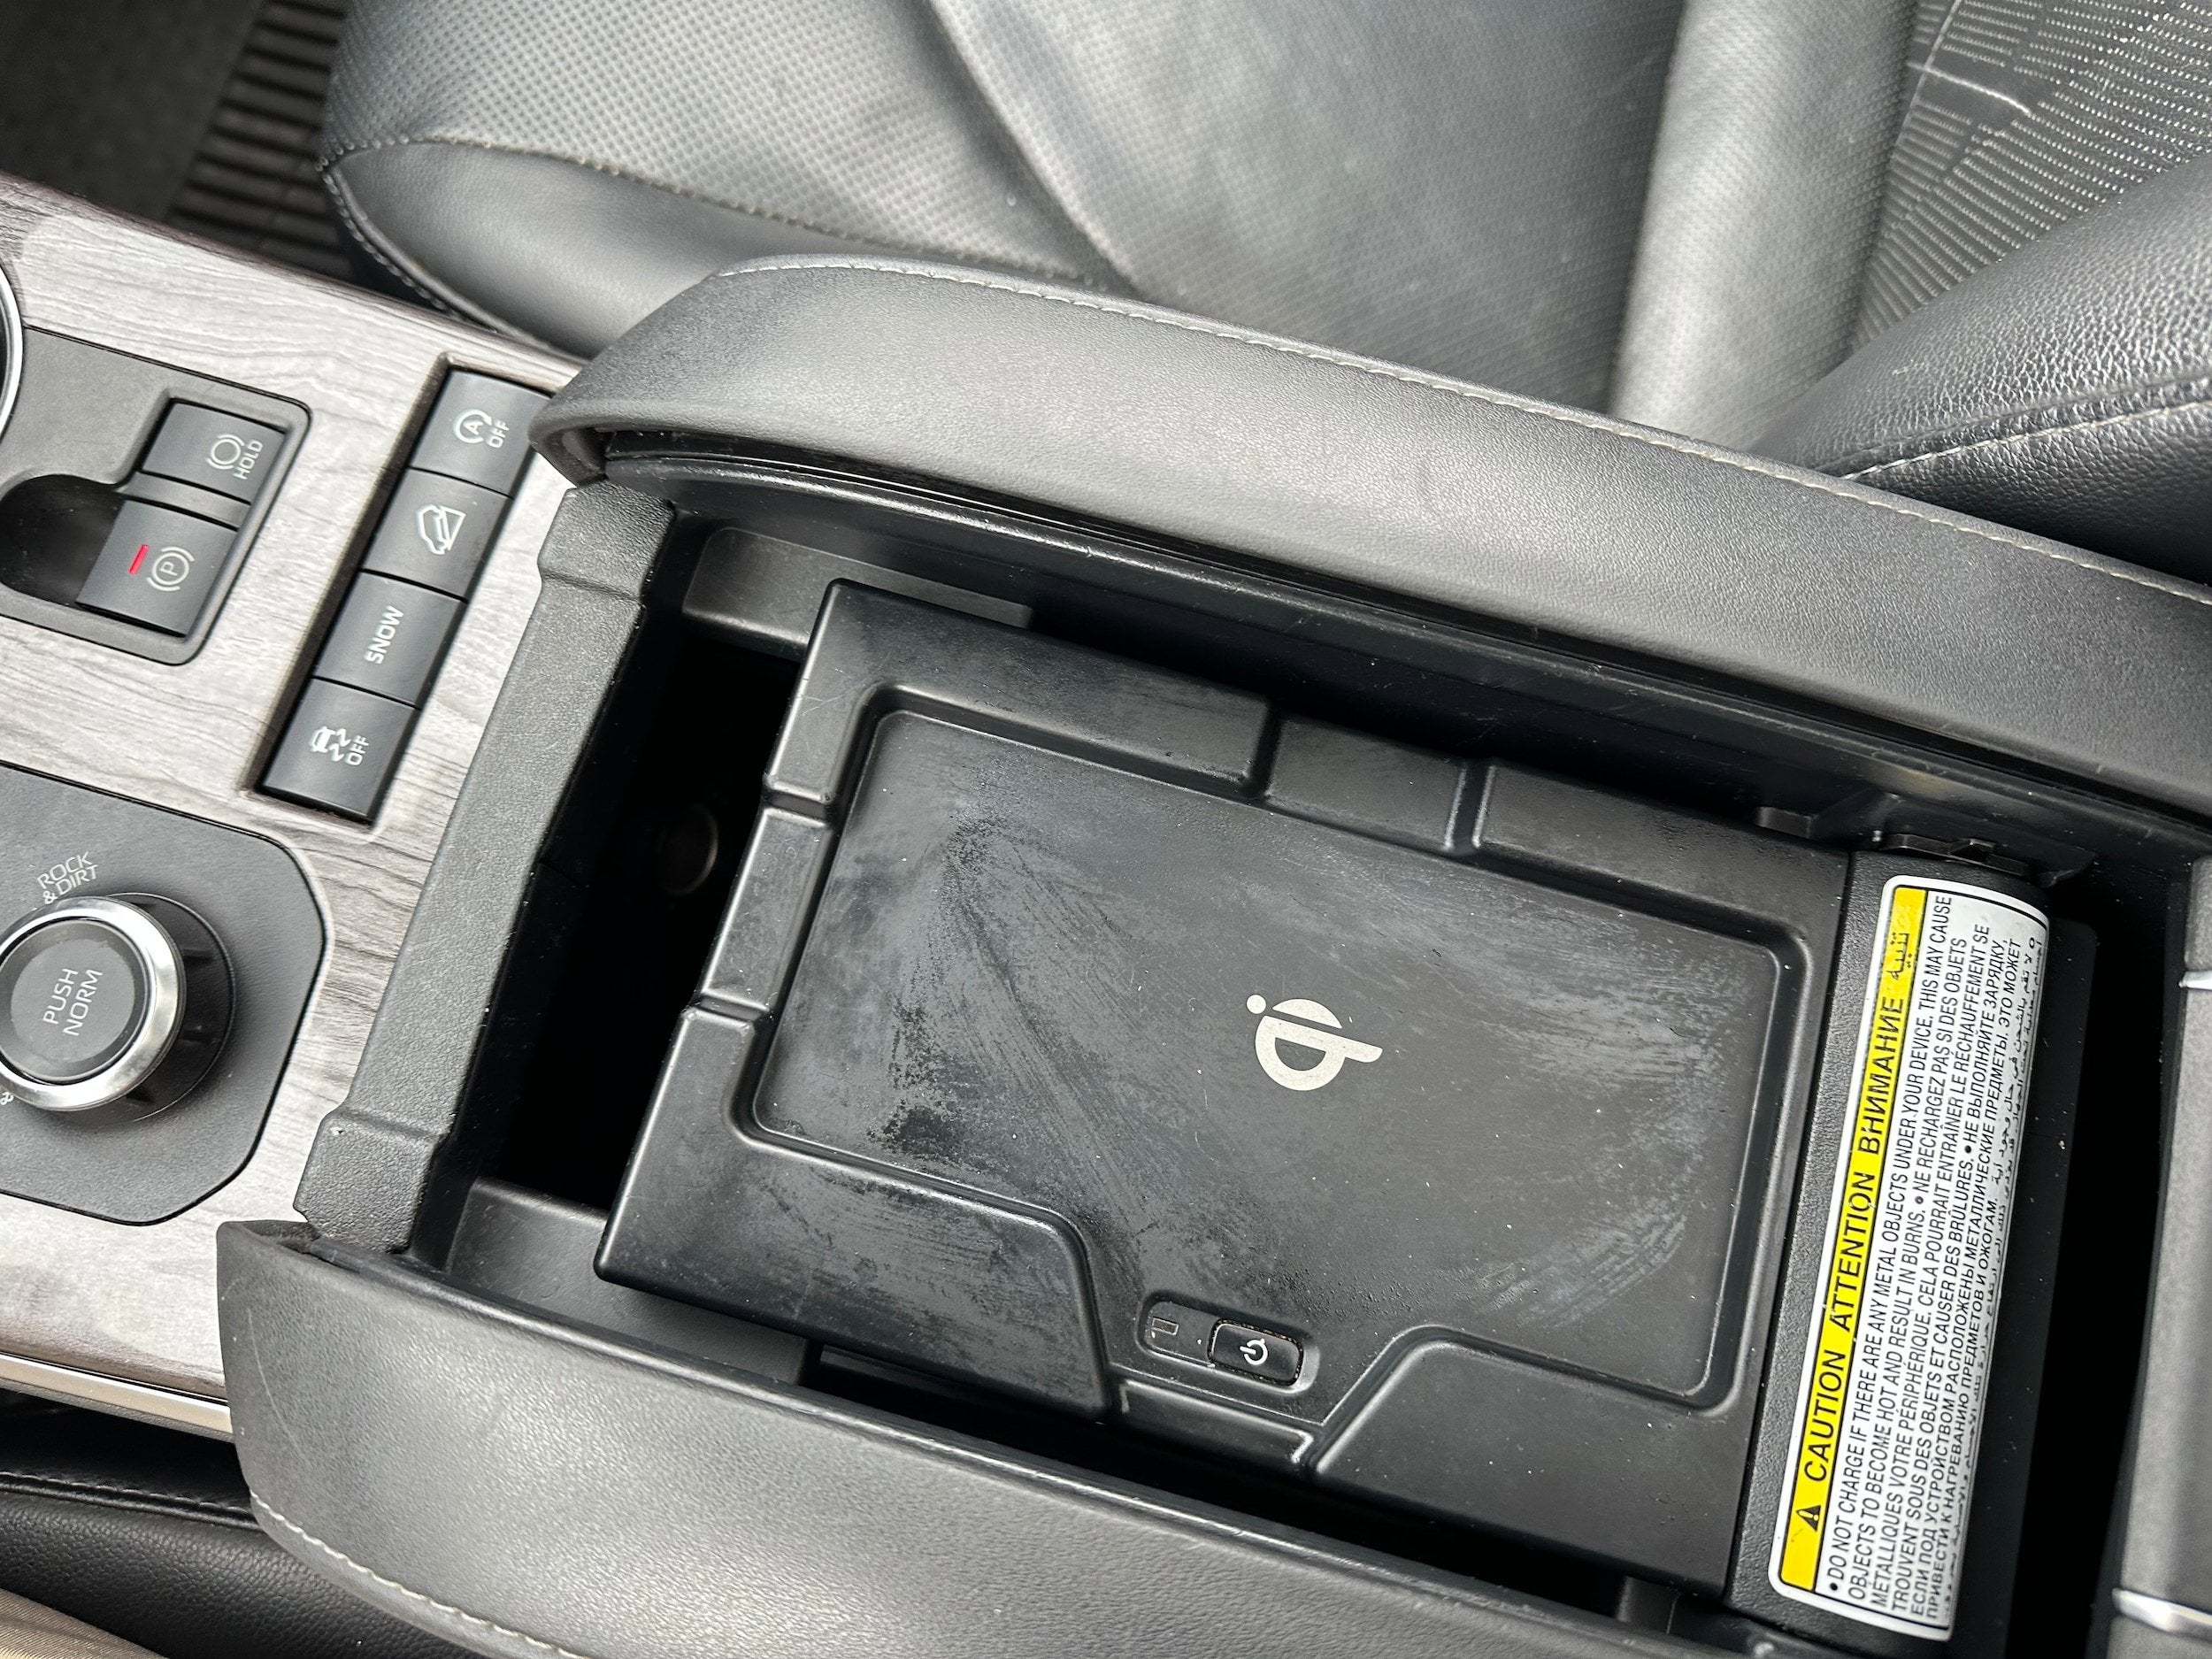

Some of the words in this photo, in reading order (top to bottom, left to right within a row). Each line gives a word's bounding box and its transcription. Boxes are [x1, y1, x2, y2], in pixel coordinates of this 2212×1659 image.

[233, 439, 264, 480] HOLD
[486, 419, 510, 449] OFF
[364, 605, 404, 665] SNOW
[345, 735, 370, 767] OFF
[36, 851, 93, 889] ROCK
[42, 890, 58, 905] &
[55, 864, 99, 895] DIRT
[1929, 895, 1952, 943] CAUSE
[1972, 924, 1990, 945] SE
[1889, 933, 1913, 981] تنبيه
[1924, 946, 1944, 977] MAY
[1943, 938, 1967, 993] OBJETS
[1983, 940, 2008, 1009] ЗАРЯДКУ,
[2002, 938, 2021, 995] МОЖЕТ
[42, 968, 79, 1025] PUSH
[62, 969, 104, 1037] NORM
[1917, 979, 1939, 1010] THIS
[1938, 996, 1958, 1026] DES
[1950, 945, 1986, 1072] RÉCHAUFFEMENT
[1998, 996, 2013, 1028] ЭТО
[1909, 1016, 1933, 1071] DEVICE.
[1931, 1045, 1951, 1075] PAS
[1935, 1028, 1954, 1043] SI
[1857, 996, 1903, 1156] ВНИМАНИЕ
[1949, 1074, 1967, 1094] LE
[1966, 1010, 1995, 1119] ВЫПОЛНЯЙТЕ
[1984, 1033, 2008, 1121] ПРЕДМЕТЫ.
[1901, 1073, 1924, 1113] YOUR
[1893, 1118, 1917, 1170] UNDER
[1916, 1076, 1946, 1169] RECHARGEZ
[1936, 1096, 1964, 1182] ENTRAÎNER
[1962, 1120, 1979, 1144] НЕ
[1881, 1172, 1909, 1242] OBJECTS
[1912, 1171, 1932, 1194] NE
[1947, 1158, 1974, 1243] BRÛLURES.
[1964, 1122, 1995, 1261] МЕТАЛЛИЧЕСКИЕ
[1901, 1210, 1926, 1266] BURNS.
[1924, 1183, 1951, 1263] POURRAIT
[1978, 1198, 1998, 1270] ОЖОГАМ.
[1872, 1247, 1897, 1297] METAL
[1897, 1267, 1916, 1286] IN
[1917, 1267, 1939, 1307] CELA
[1942, 1245, 1961, 1278] DES
[1976, 1273, 1987, 1286] И
[1803, 1349, 1846, 1482] CAUTION
[1829, 1171, 1876, 1333] ATTENTION
[1867, 1298, 1888, 1333] ANY
[1888, 1286, 1913, 1348] RESULT
[1932, 1279, 1956, 1345] CAUSER
[1944, 1263, 1975, 1394] РАСПОЛОЖЕНЫ
[1862, 1333, 1883, 1369] ARE
[1929, 1346, 1946, 1369] ET
[1961, 1289, 1985, 1389] ПРЕДМЕТОВ
[1882, 1350, 1903, 1386] AND
[1896, 1312, 1932, 1432] PÉRIPHÉRIQUE.
[1852, 1369, 1877, 1422] THERE
[1876, 1386, 1898, 1422] HOT
[1919, 1371, 1942, 1434] OBJETS
[1848, 1425, 1867, 1442] IF
[1864, 1423, 1892, 1495] BECOME
[1888, 1432, 1913, 1487] VOTRE
[1913, 1437, 1932, 1471] DES
[1943, 1393, 1970, 1509] НАГРЕВАНИЮ
[1838, 1443, 1865, 1514] CHARGE
[1924, 1397, 1955, 1524] УСТРОЙСТВОМ
[1860, 1497, 1880, 1519] TO
[1905, 1473, 1927, 1521] SOUS
[1940, 1512, 1953, 1524] К
[1832, 1515, 1854, 1553] NOT
[1869, 1492, 1904, 1608] MÉTALLIQUES
[1918, 1528, 1939, 1565] ПОД
[1826, 1555, 1847, 1581] DO
[1847, 1523, 1877, 1601] OBJECTS
[1891, 1521, 1919, 1610] TROUVENT
[1926, 1527, 1950, 1619] ПРИВЕСТИ
